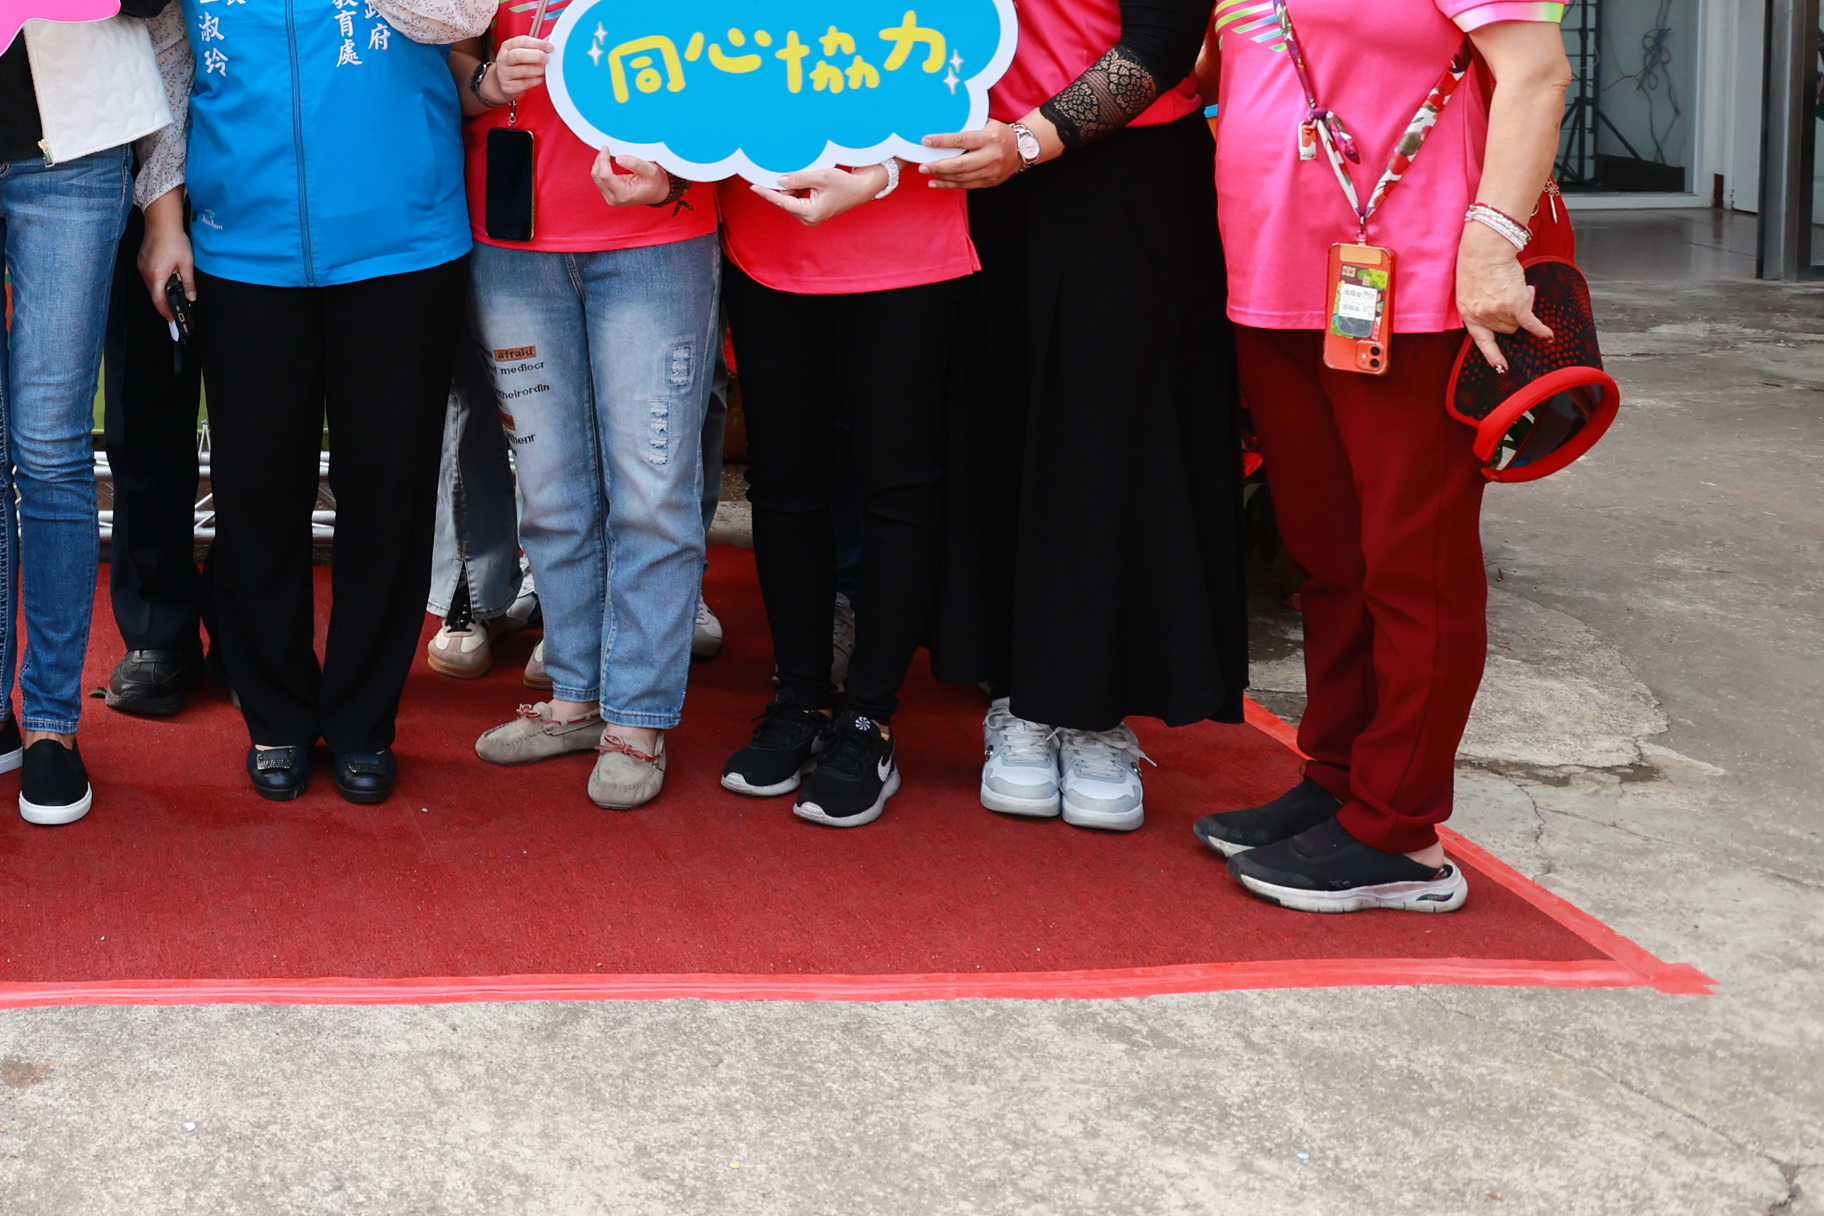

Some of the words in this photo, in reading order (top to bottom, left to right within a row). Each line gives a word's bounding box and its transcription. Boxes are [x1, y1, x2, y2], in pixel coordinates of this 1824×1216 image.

[608, 10, 947, 104] 同心協力
[498, 347, 533, 359] afraid
